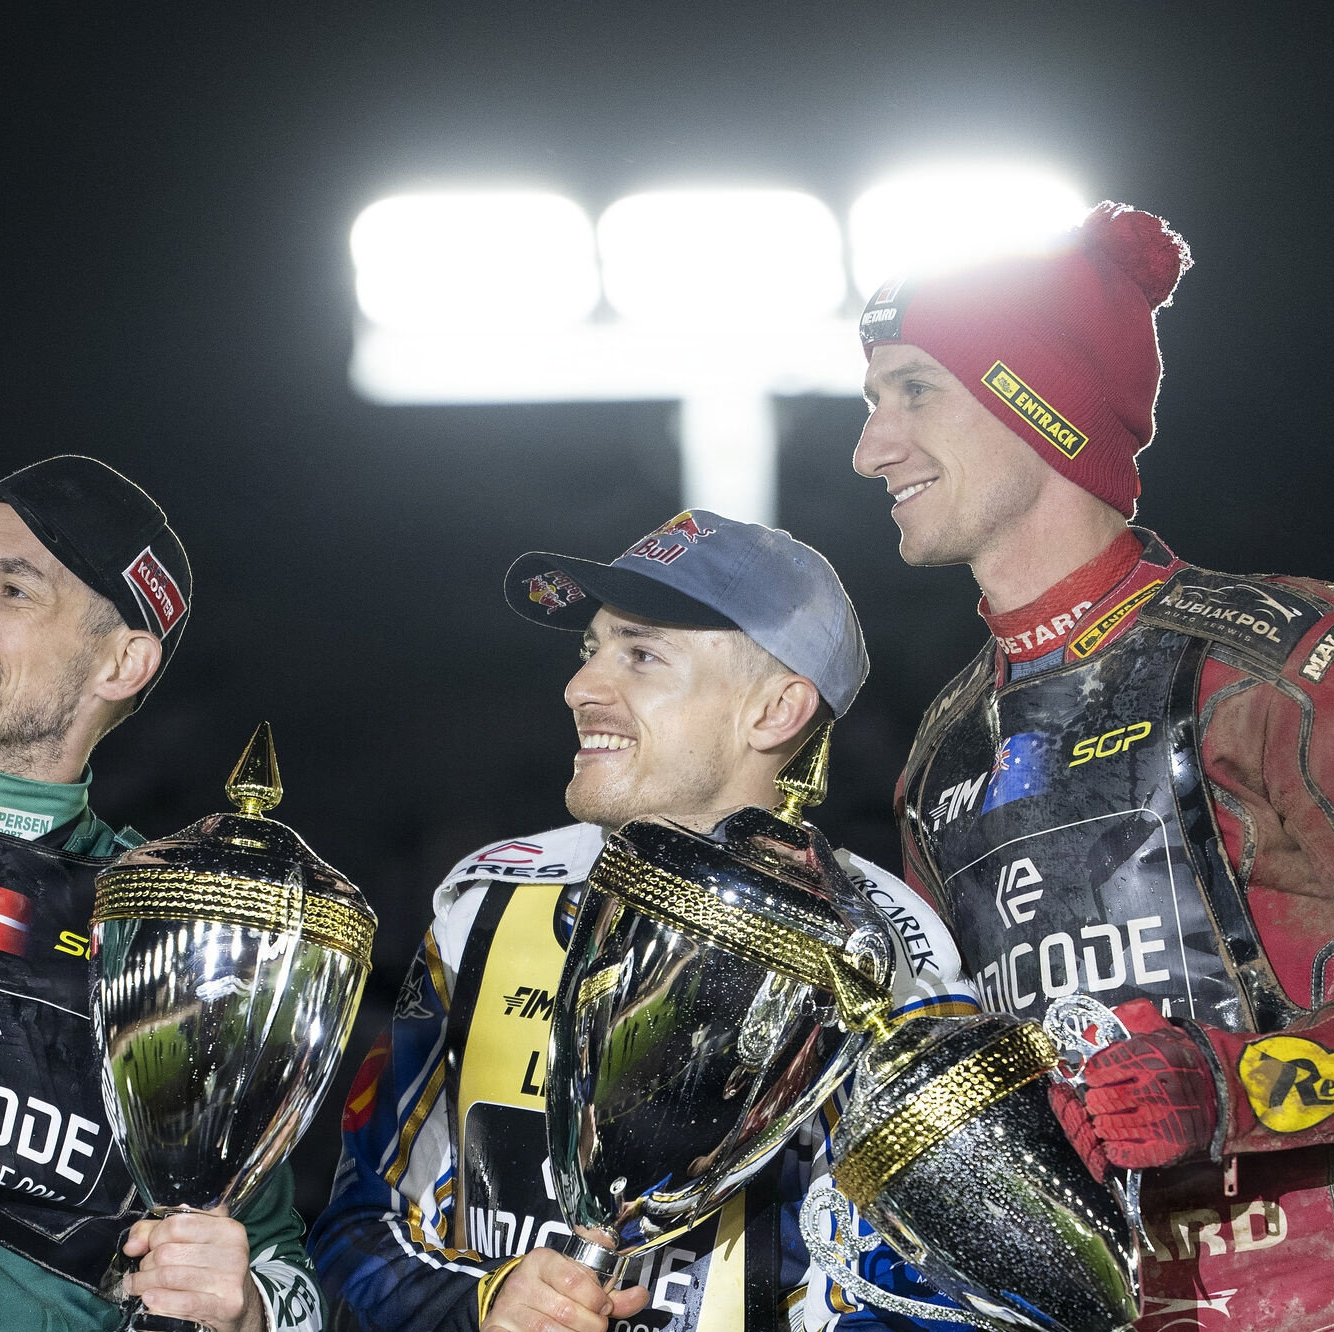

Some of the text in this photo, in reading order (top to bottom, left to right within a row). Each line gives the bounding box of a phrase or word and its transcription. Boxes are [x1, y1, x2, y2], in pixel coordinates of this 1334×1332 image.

[1014, 391, 1079, 450] ENTRACK
[632, 538, 688, 566] Bull
[137, 561, 175, 621] KLOSTER
[1203, 621, 1252, 643] SERWIS
[1069, 721, 1153, 768] SGP
[929, 772, 988, 832] FIM
[976, 915, 1171, 1015] DICODE
[503, 986, 558, 1022] FIM
[1142, 1200, 1288, 1262] ARD
